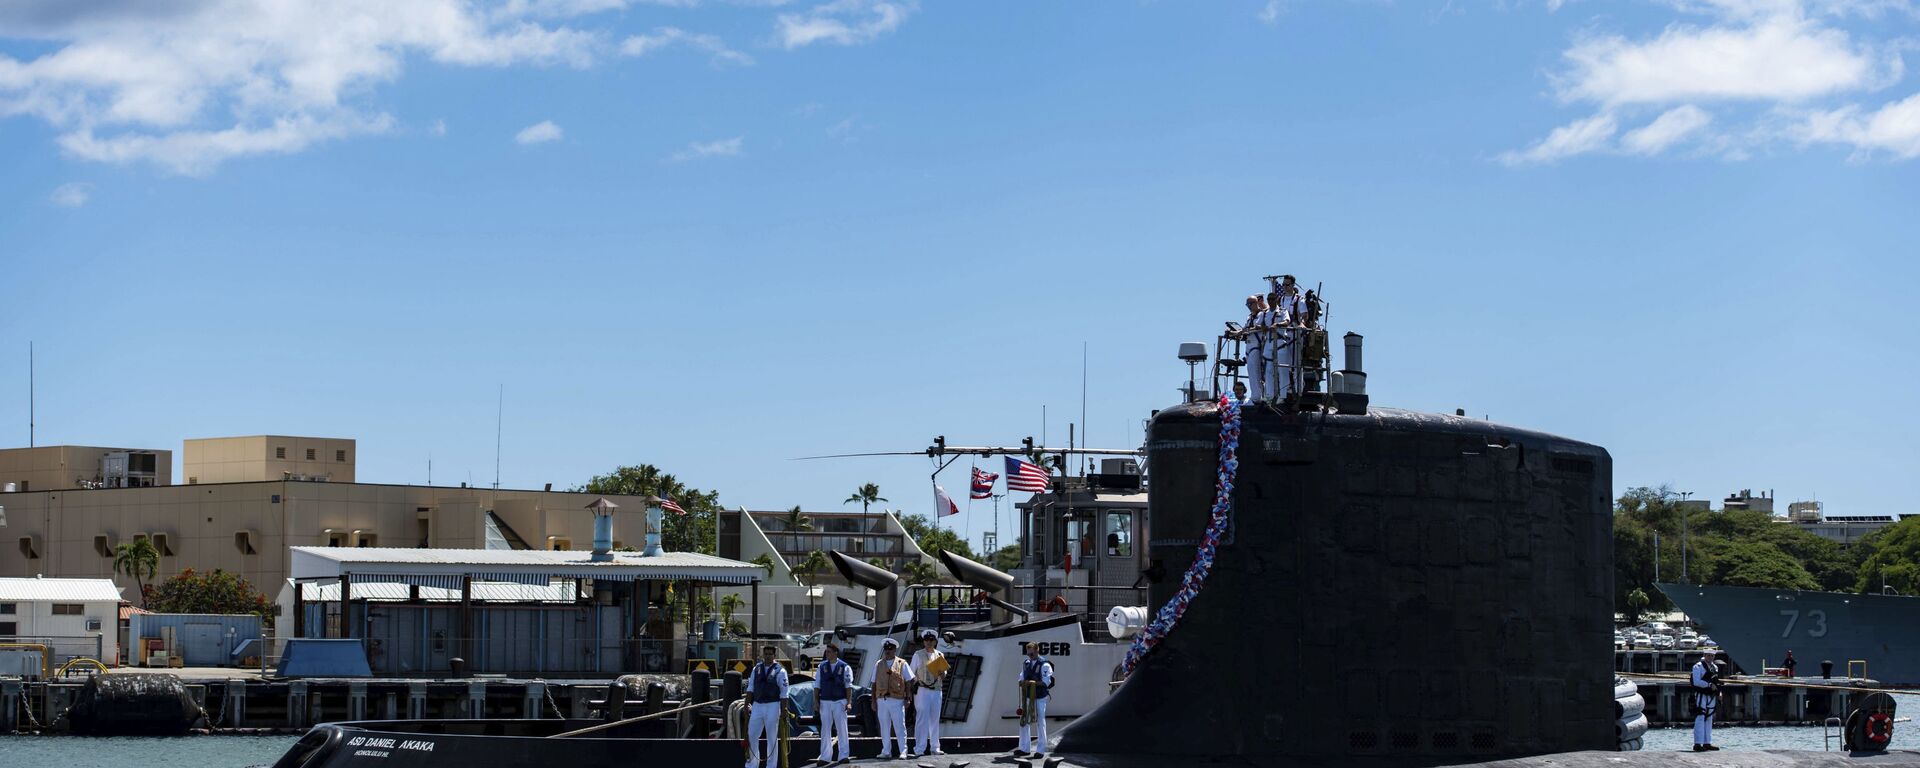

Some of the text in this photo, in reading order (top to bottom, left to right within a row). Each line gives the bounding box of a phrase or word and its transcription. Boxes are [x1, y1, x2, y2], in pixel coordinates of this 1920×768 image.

[1780, 609, 1827, 638] 73
[1018, 641, 1071, 656] TGER
[347, 736, 435, 751] ASD DANIEL AKAKA
